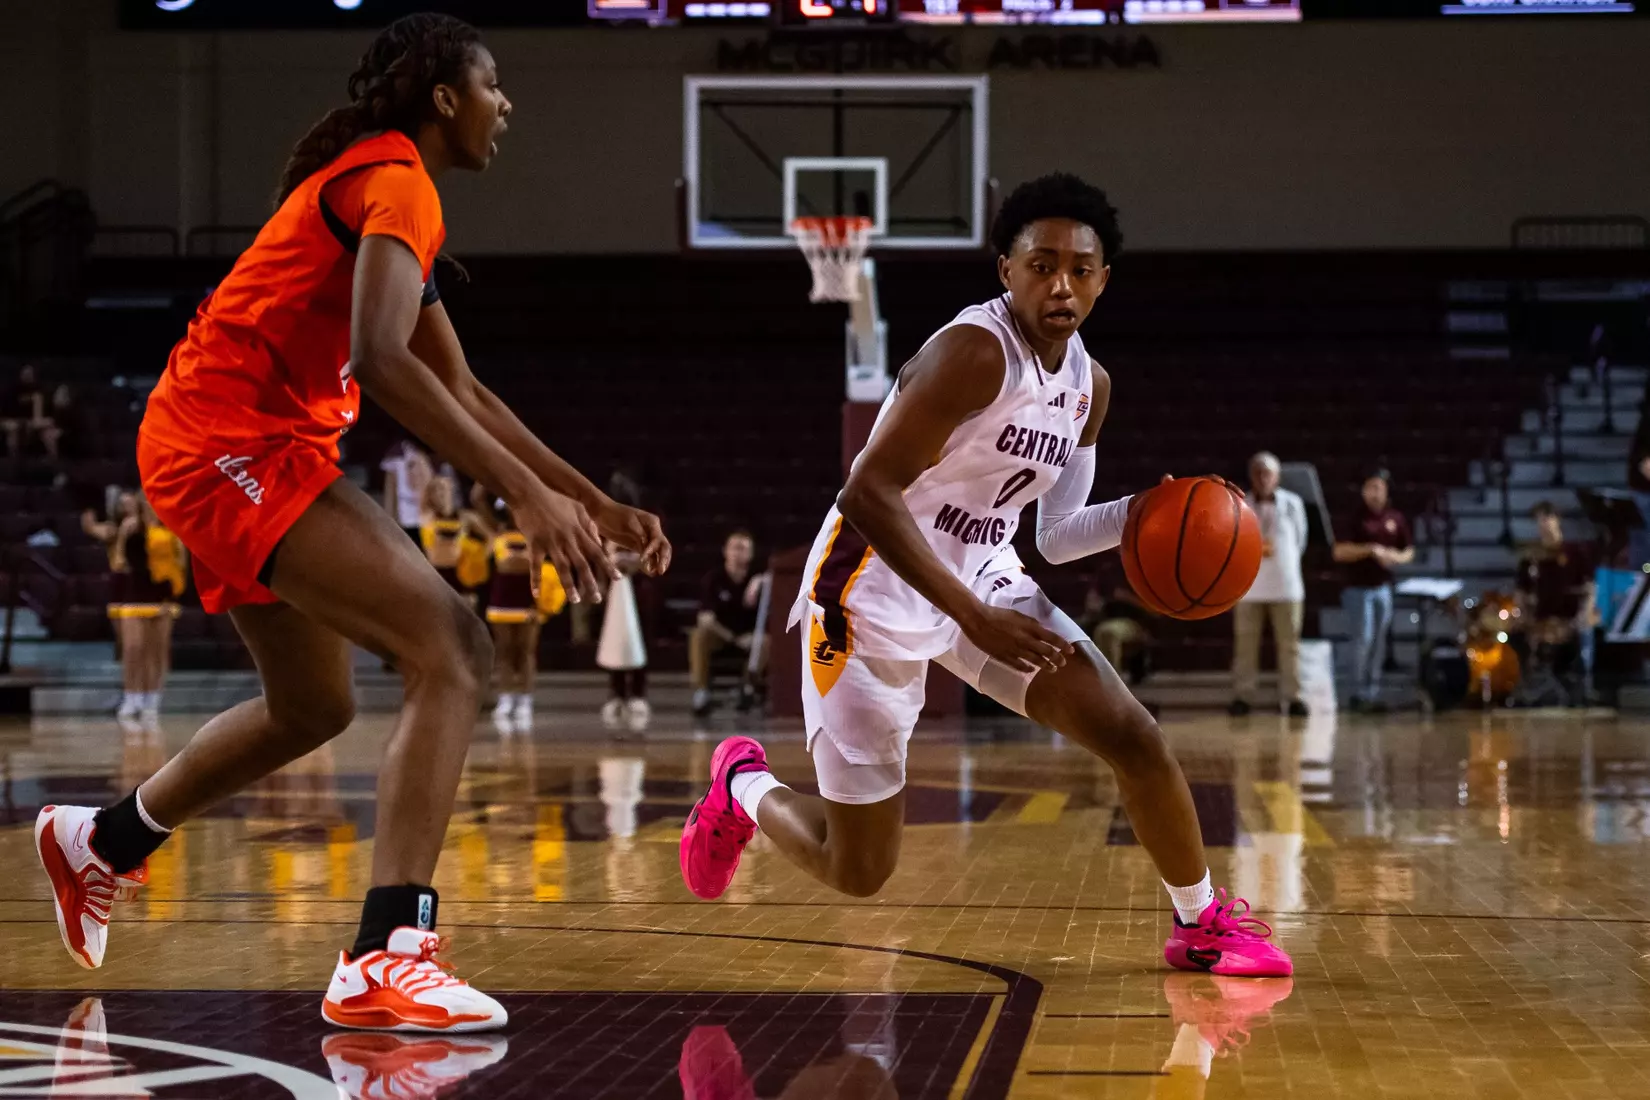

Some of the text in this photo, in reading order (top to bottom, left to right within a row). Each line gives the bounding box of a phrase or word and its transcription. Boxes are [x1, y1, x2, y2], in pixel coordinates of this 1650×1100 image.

[988, 34, 1162, 68] ARENA
[996, 424, 1073, 467] CENTRAL
[992, 467, 1036, 509] 0
[933, 503, 1013, 547] MICHIG
